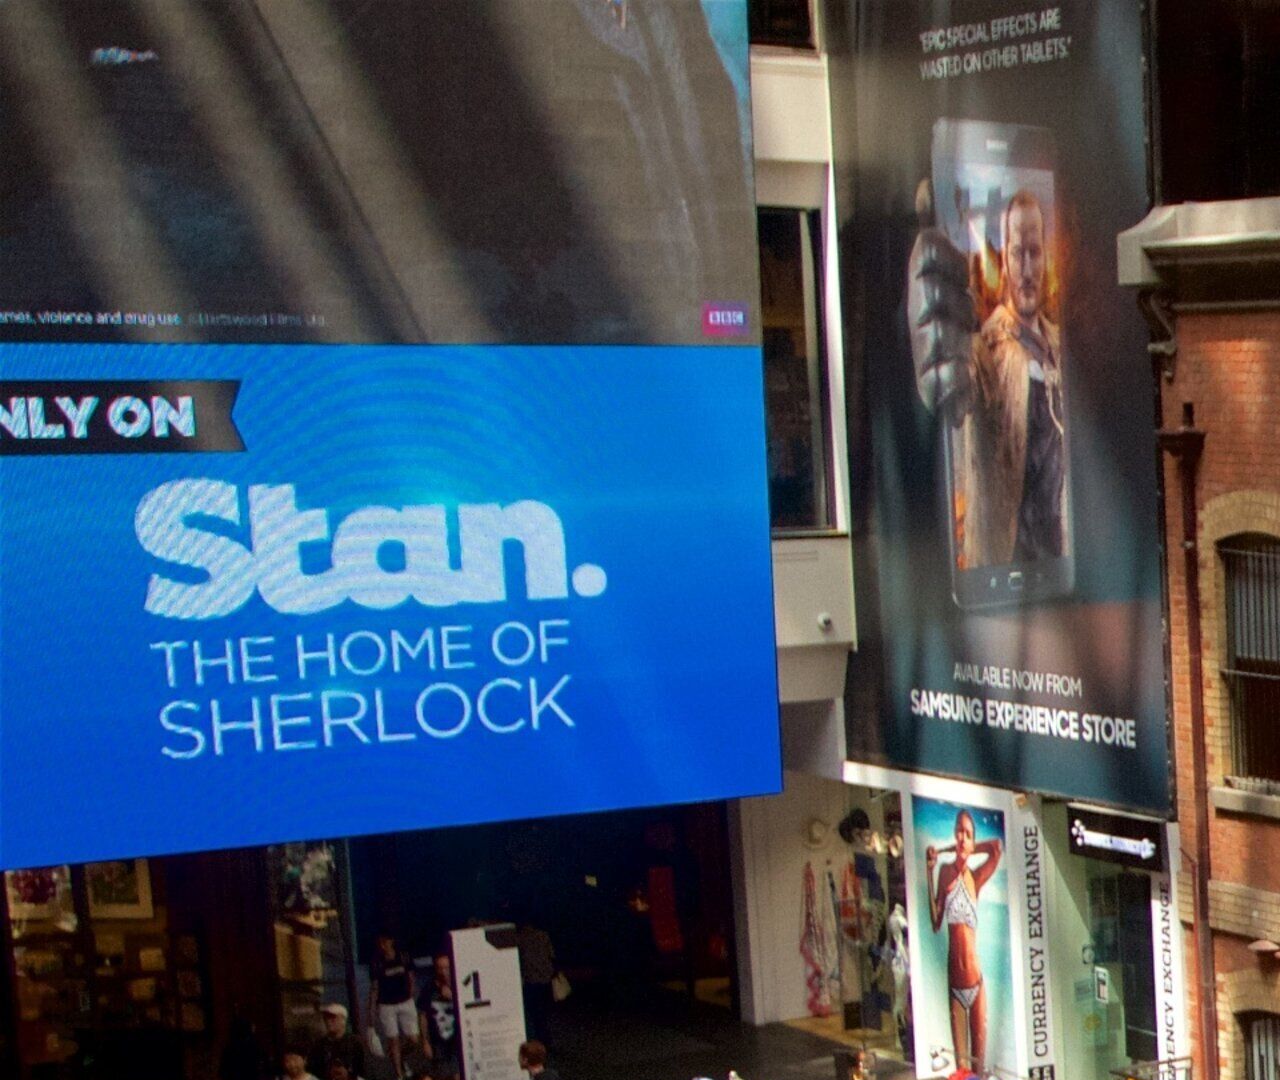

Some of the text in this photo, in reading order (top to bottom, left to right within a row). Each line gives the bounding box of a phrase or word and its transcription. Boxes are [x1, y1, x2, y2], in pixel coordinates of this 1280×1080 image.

[947, 23, 989, 48] SPECIAL
[991, 13, 1037, 41] EFFECTS
[1039, 8, 1061, 32] ARE
[920, 56, 962, 80] WASTED
[964, 52, 981, 73] ON
[983, 45, 1018, 71] OTHER
[37, 310, 93, 325] violence
[96, 310, 122, 325] and
[125, 310, 155, 328] drug
[157, 312, 182, 326] use
[107, 395, 195, 439] ON
[134, 477, 607, 620] Stan.
[150, 618, 571, 688] THE HOME OF
[953, 662, 1082, 697] AVAILABLE NOW FROM
[159, 674, 575, 759] SHERLOCK
[911, 689, 1136, 748] SAMSUNG EXPERIENCE STORE
[1023, 824, 1044, 940] EXCHANGE
[462, 970, 491, 1010] 1
[1029, 947, 1048, 1058] CURRENCY
